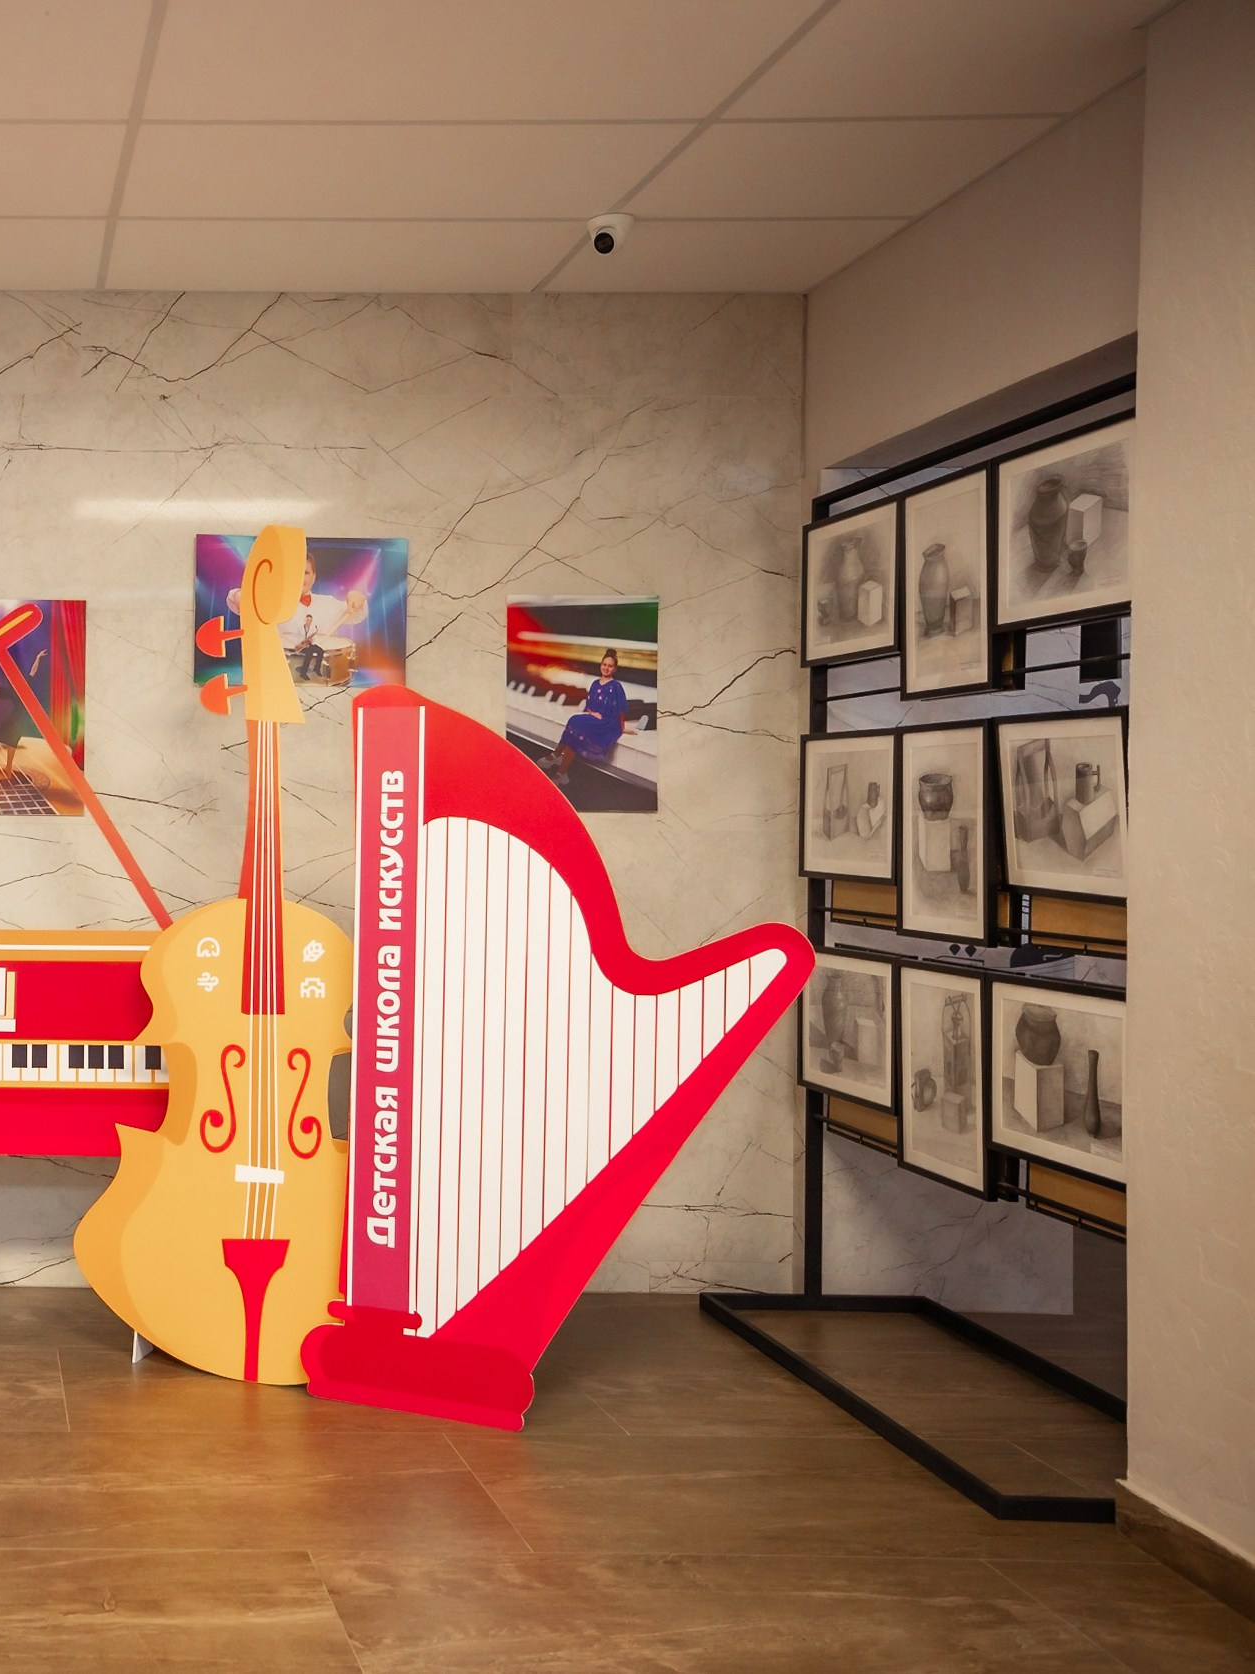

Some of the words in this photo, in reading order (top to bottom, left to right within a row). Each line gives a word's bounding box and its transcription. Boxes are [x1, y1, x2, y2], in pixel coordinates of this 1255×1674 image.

[378, 770, 405, 931] искусств
[375, 945, 402, 1073] школа
[366, 1086, 399, 1249] Детская
